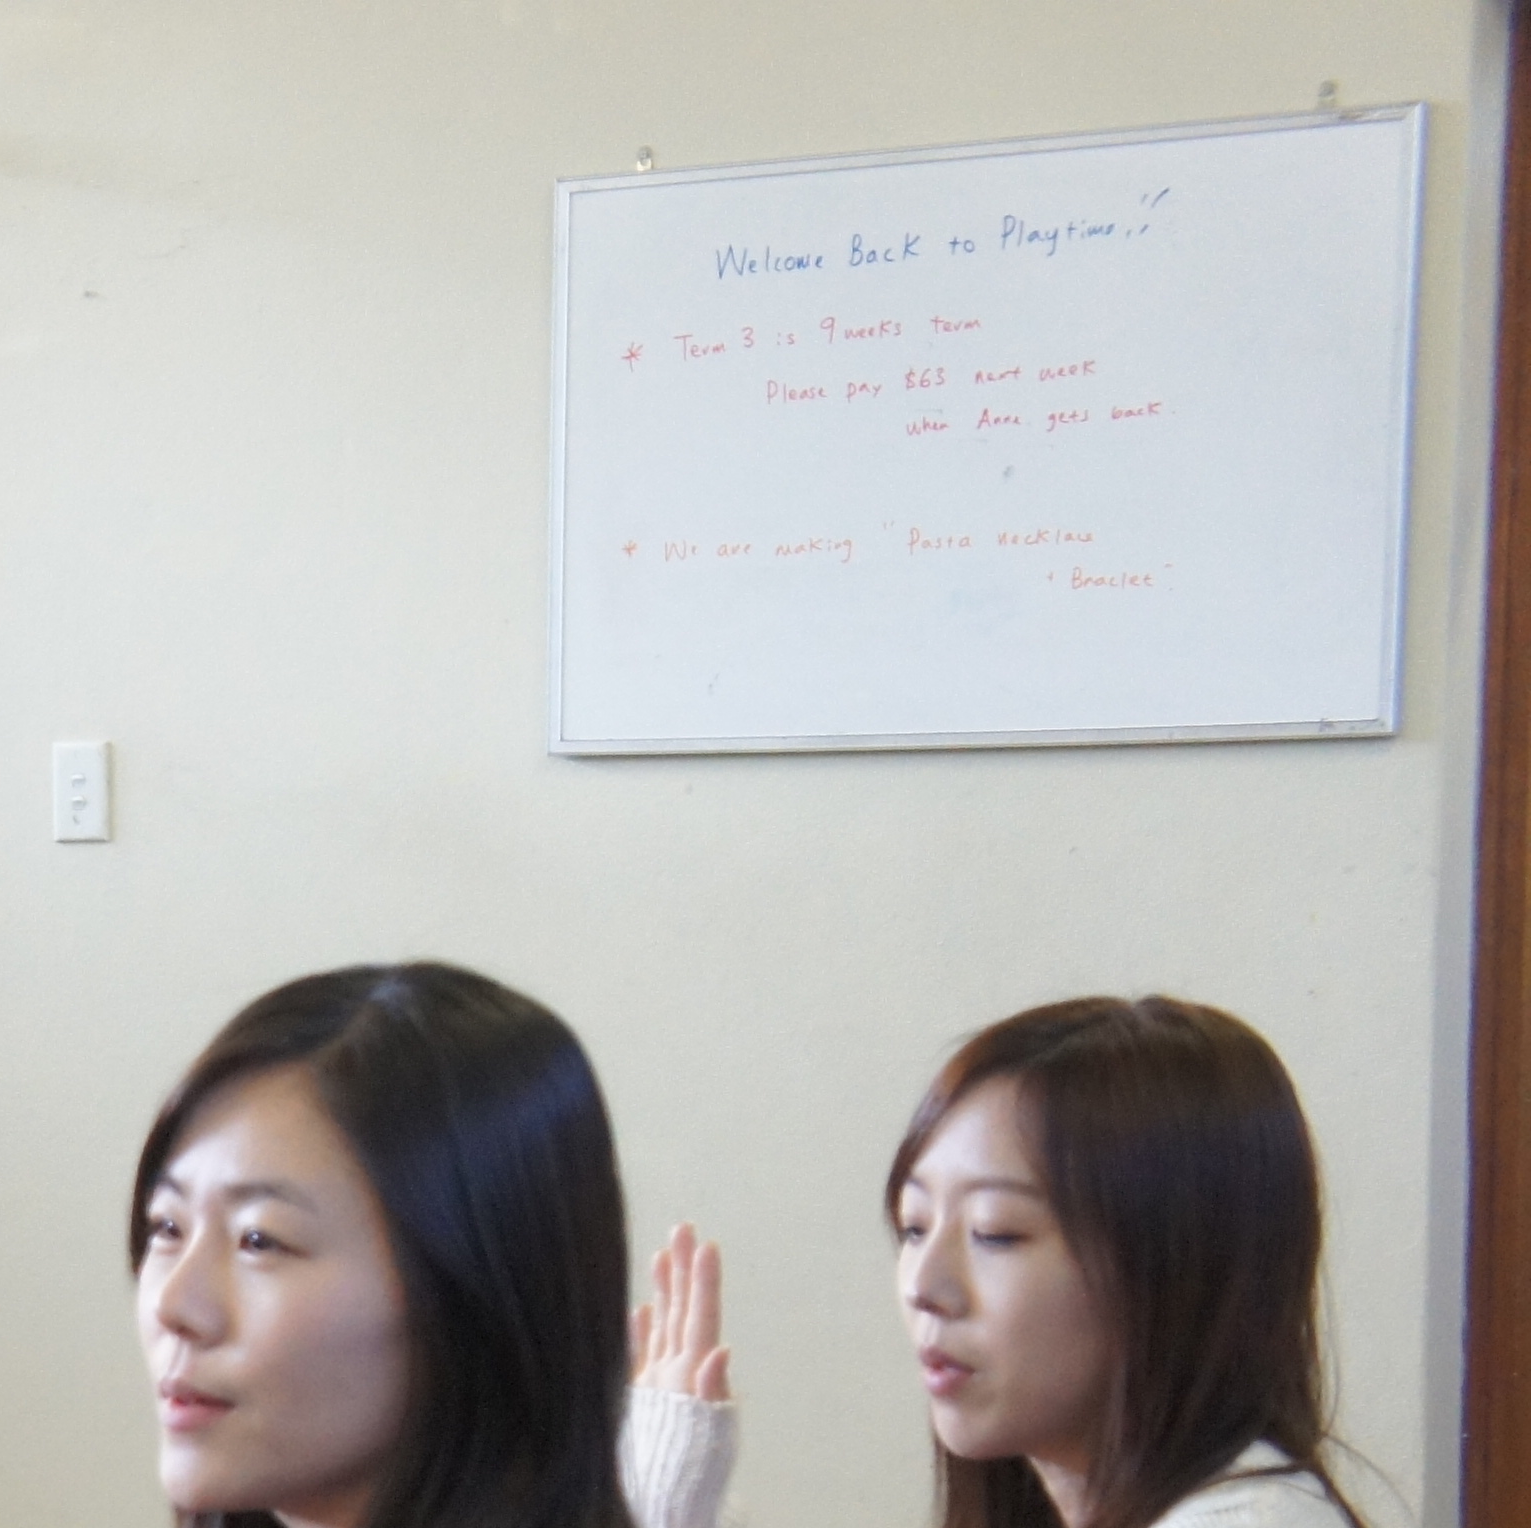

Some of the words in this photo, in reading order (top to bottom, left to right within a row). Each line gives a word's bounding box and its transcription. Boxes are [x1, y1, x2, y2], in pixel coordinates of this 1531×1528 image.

[716, 244, 824, 280] Welcome
[848, 232, 921, 268] Back
[948, 236, 976, 255] to
[674, 335, 725, 362] Term
[741, 327, 755, 348] 3
[777, 331, 795, 346] is
[820, 316, 835, 344] 9
[844, 319, 903, 340] weeks
[930, 315, 981, 335] term
[767, 379, 827, 404] Please
[847, 382, 882, 403] pay
[974, 366, 1021, 385] next
[1039, 360, 1096, 382] week
[906, 416, 950, 436] when
[1045, 408, 1089, 432] gets
[664, 540, 698, 562] We
[717, 543, 752, 557] are
[775, 537, 853, 563] making
